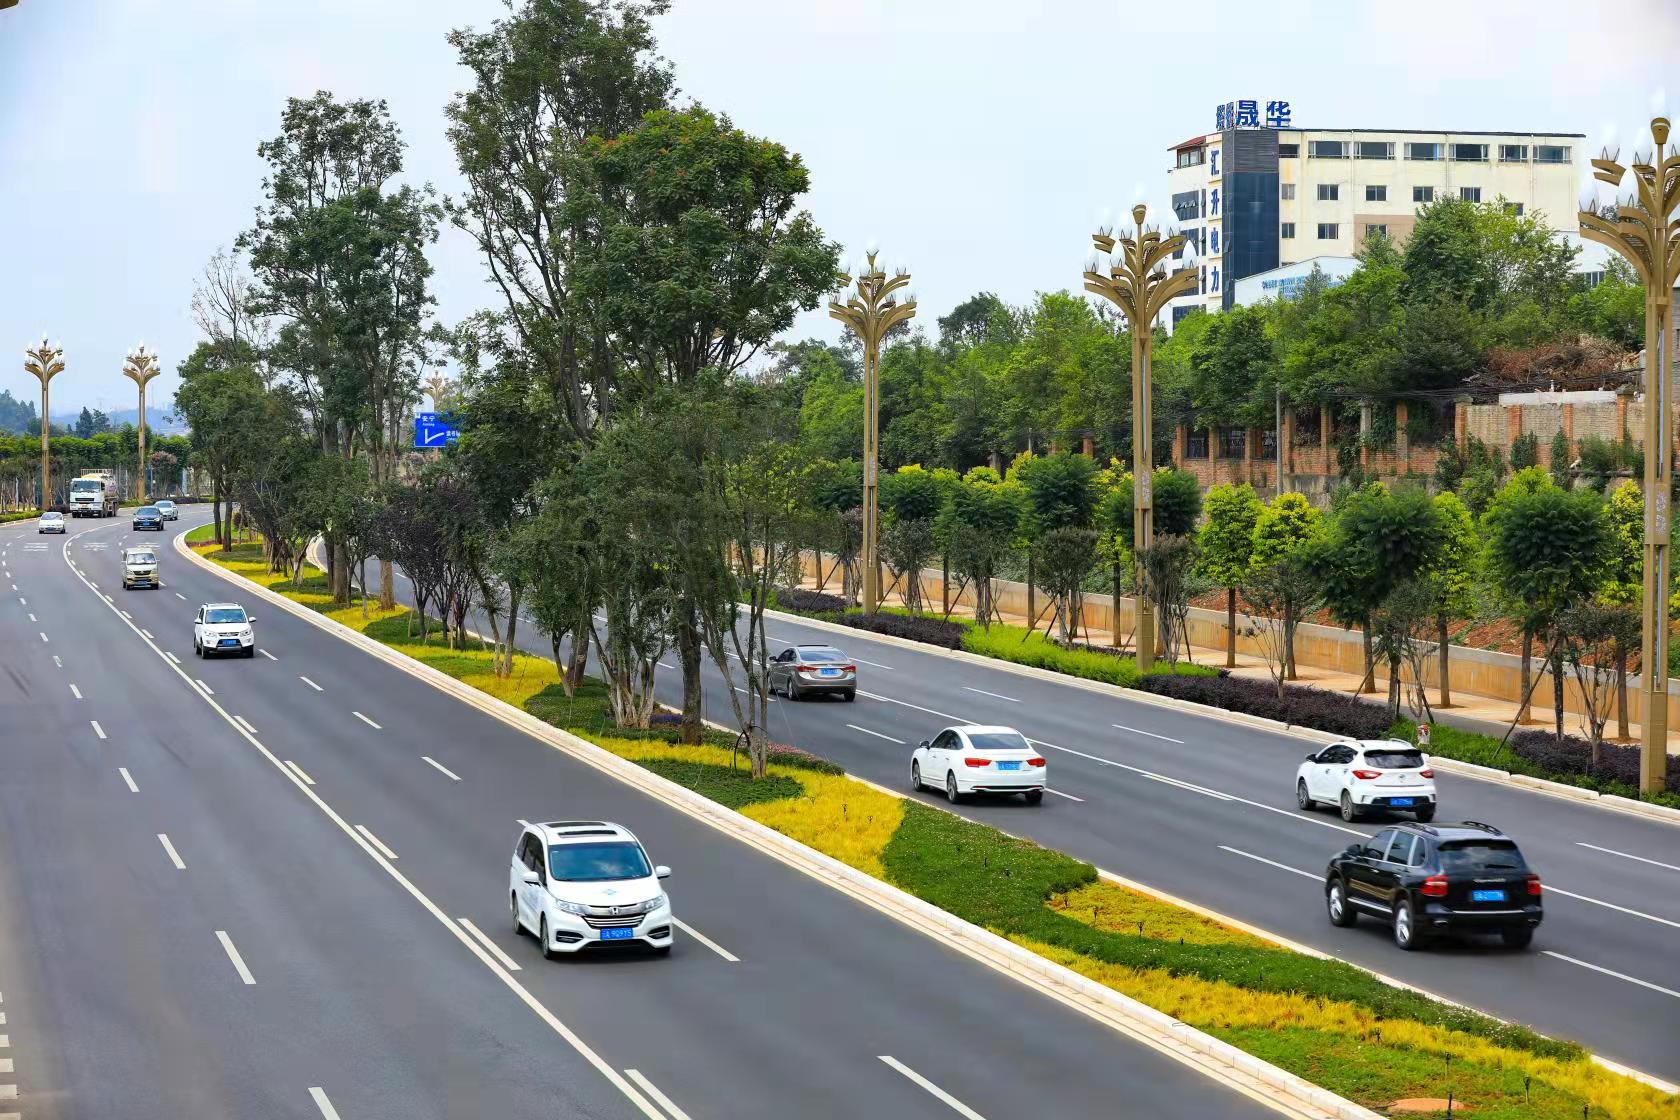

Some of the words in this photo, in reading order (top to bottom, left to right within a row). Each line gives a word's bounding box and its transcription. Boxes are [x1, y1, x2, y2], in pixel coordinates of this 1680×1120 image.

[1236, 100, 1291, 127] 晟华
[1210, 149, 1220, 293] 汇升电力
